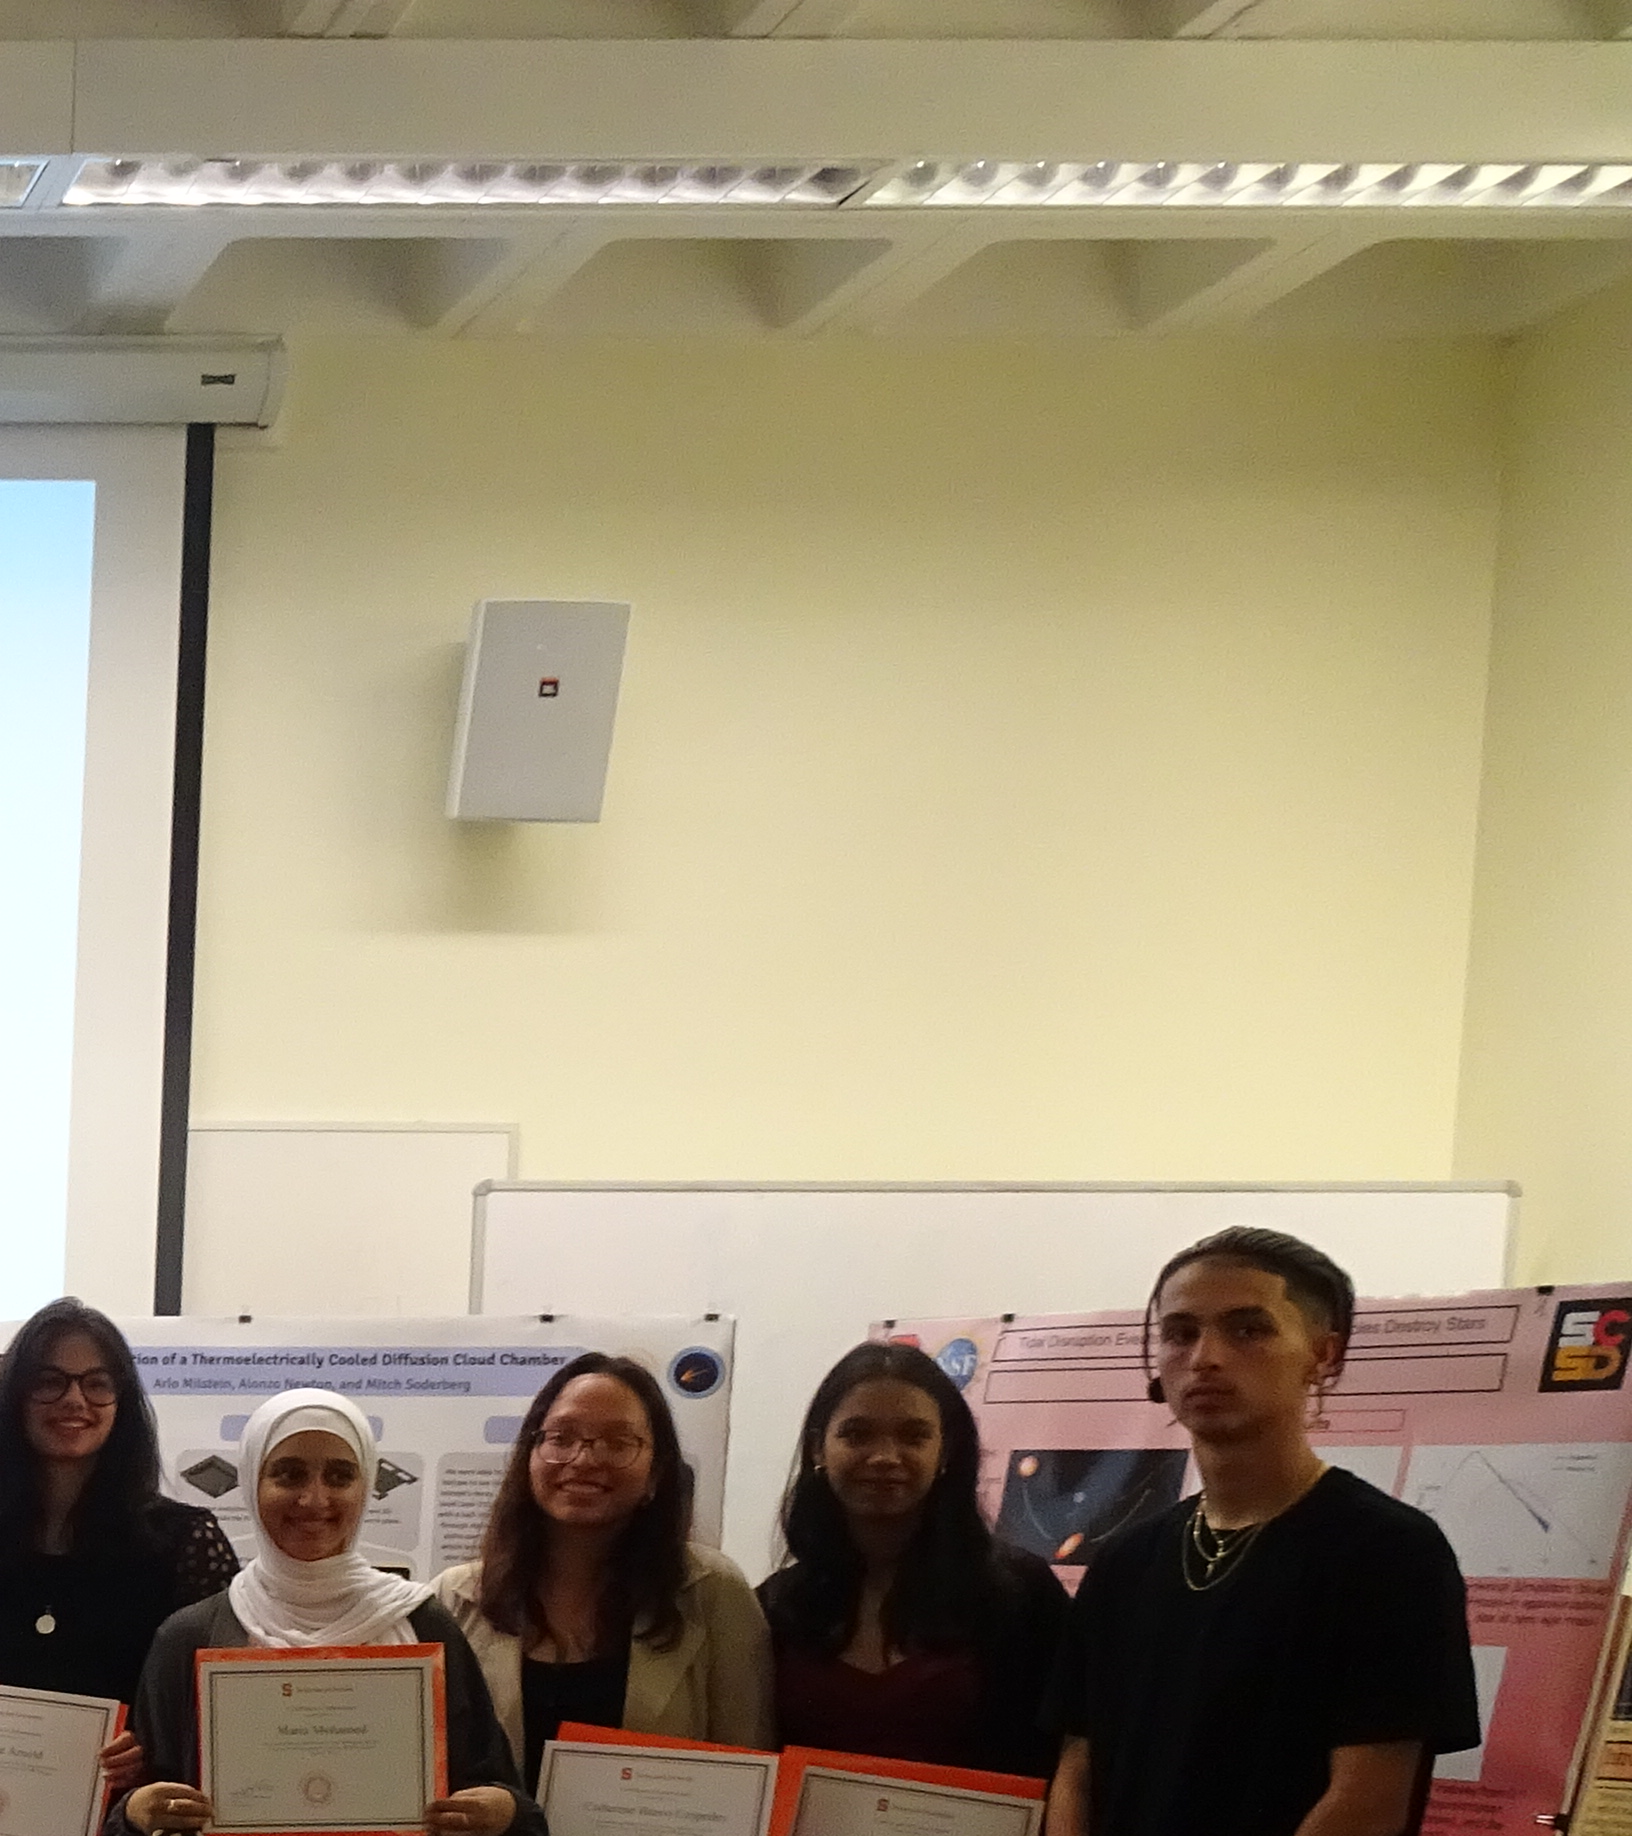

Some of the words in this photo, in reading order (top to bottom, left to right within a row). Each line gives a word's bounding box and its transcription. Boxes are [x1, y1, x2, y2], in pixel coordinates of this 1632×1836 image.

[1385, 1318, 1440, 1335] Destroy
[1445, 1316, 1487, 1331] Stars
[1558, 1309, 1630, 1348] SC
[1047, 1335, 1109, 1349] Disruption
[162, 1352, 177, 1366] of
[180, 1355, 188, 1366] a
[191, 1352, 324, 1369] Thermoelectrically
[328, 1353, 377, 1367] Cooled
[381, 1352, 449, 1367] Diffusion
[453, 1353, 496, 1367] Cloud
[499, 1353, 567, 1367] Chamber
[1552, 1346, 1621, 1381] SD
[153, 1377, 179, 1389] Arlo
[339, 1380, 362, 1390] and
[365, 1378, 402, 1391] Mitch
[405, 1379, 472, 1393] Soderberg
[281, 1683, 292, 1697] S
[621, 1767, 632, 1780] S
[876, 1799, 889, 1812] S
